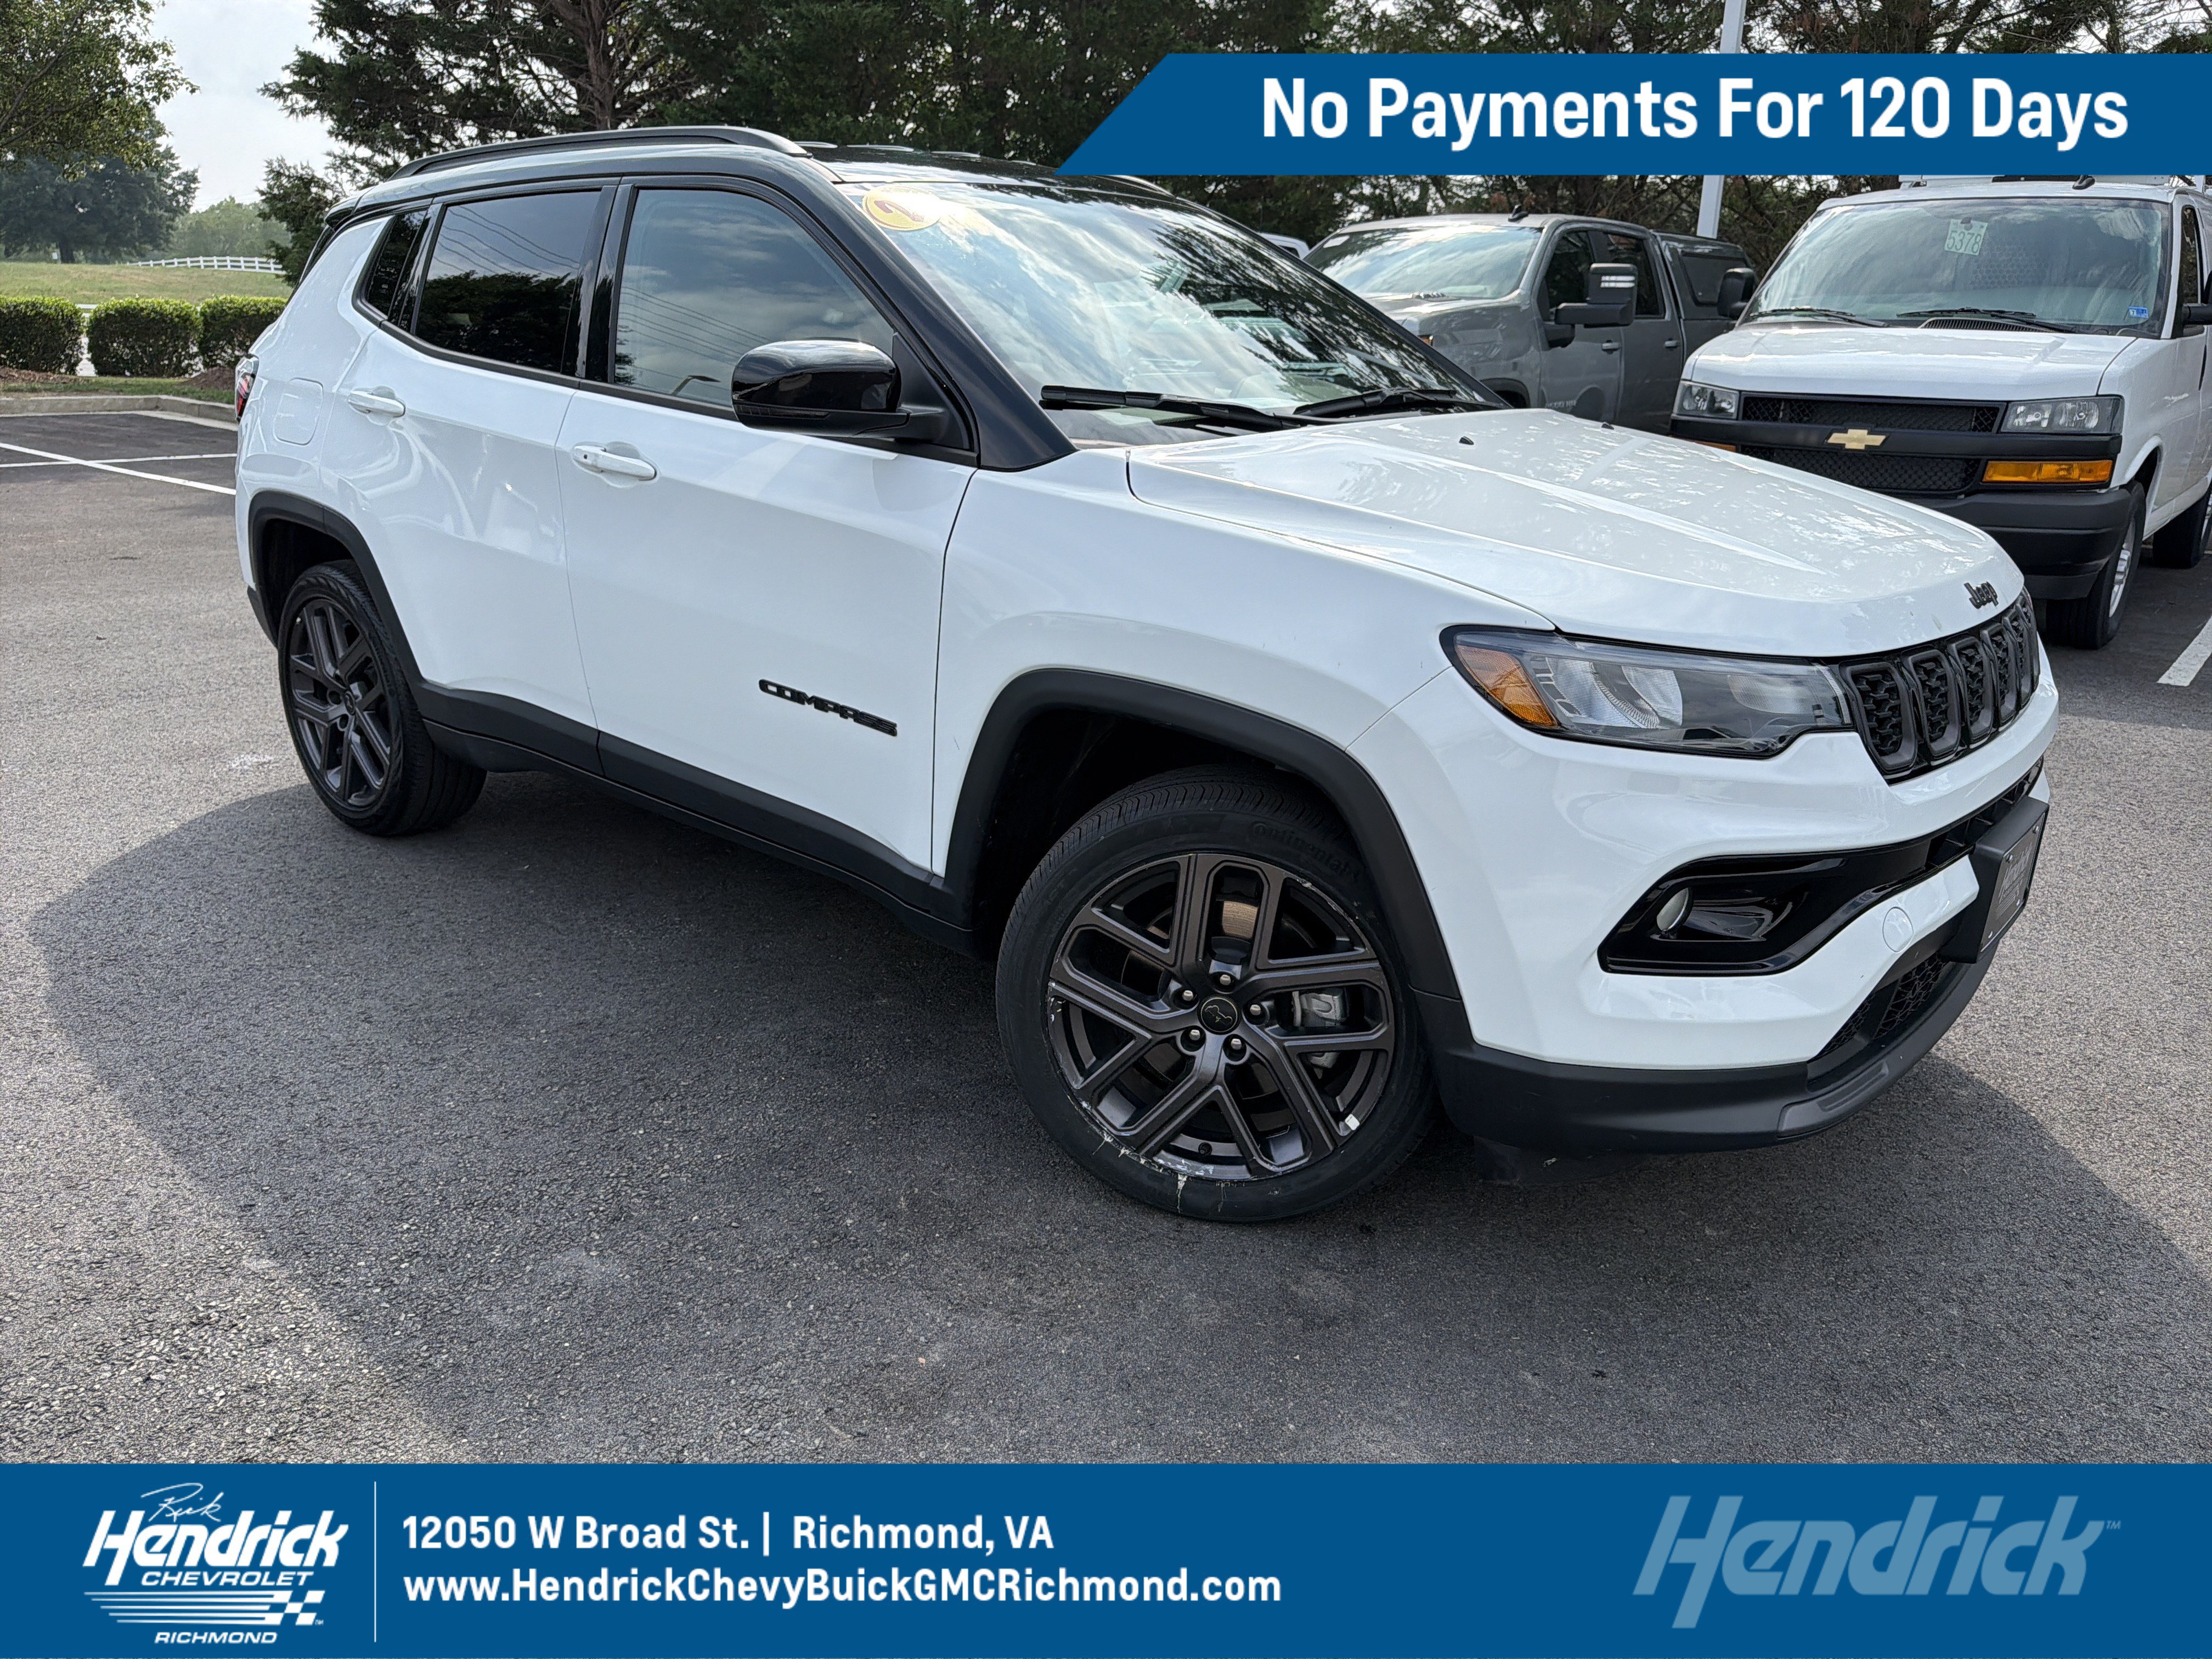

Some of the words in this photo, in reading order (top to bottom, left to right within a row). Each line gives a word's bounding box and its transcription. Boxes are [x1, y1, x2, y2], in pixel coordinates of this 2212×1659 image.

[1946, 230, 1982, 253] 5378
[1963, 581, 1999, 609] Jeep
[759, 679, 898, 737] COMPASS
